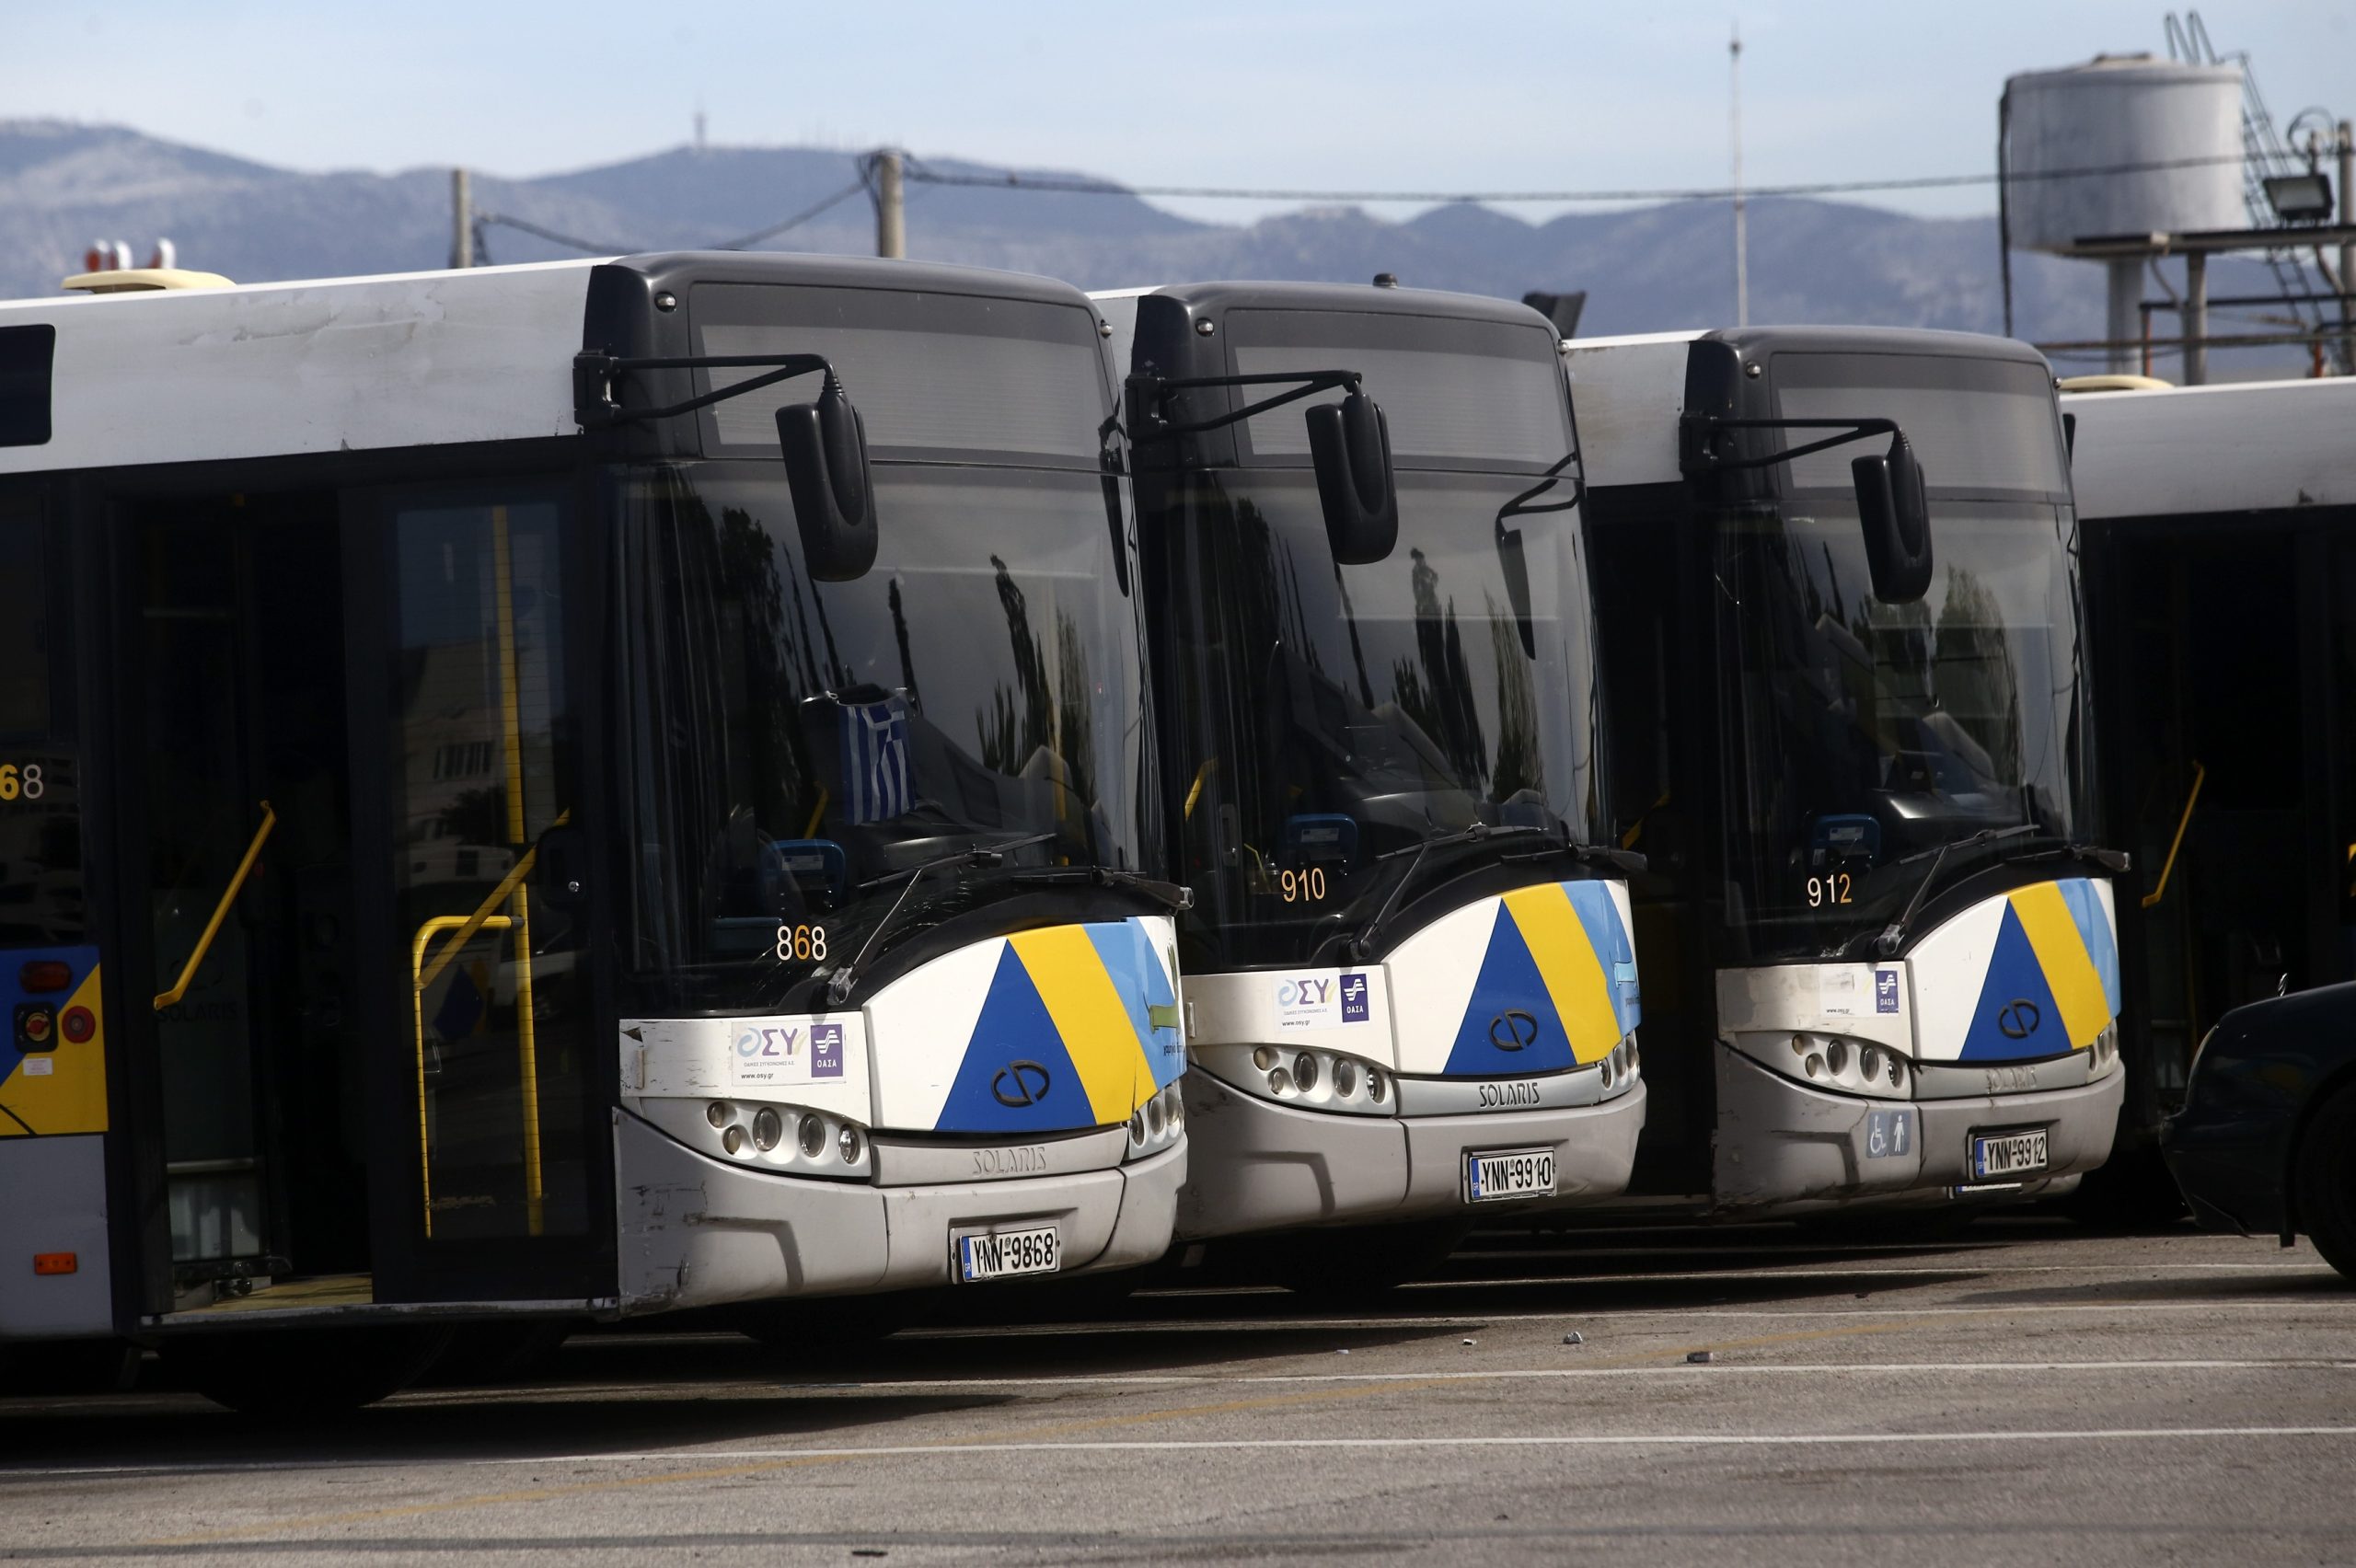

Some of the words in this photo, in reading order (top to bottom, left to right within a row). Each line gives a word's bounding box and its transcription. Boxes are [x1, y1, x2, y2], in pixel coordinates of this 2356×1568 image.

[1281, 868, 1325, 903] 910
[1807, 873, 1853, 907] 912
[777, 925, 827, 961] 868
[741, 1072, 774, 1080] www.osy.gr
[1479, 1082, 1541, 1108] SOLARIS
[973, 1147, 1046, 1174] SOLARIS
[1988, 1136, 2045, 1170] YNN-9912
[1483, 1157, 1552, 1193] YNN-9910
[974, 1232, 1054, 1274] YNN-9868
